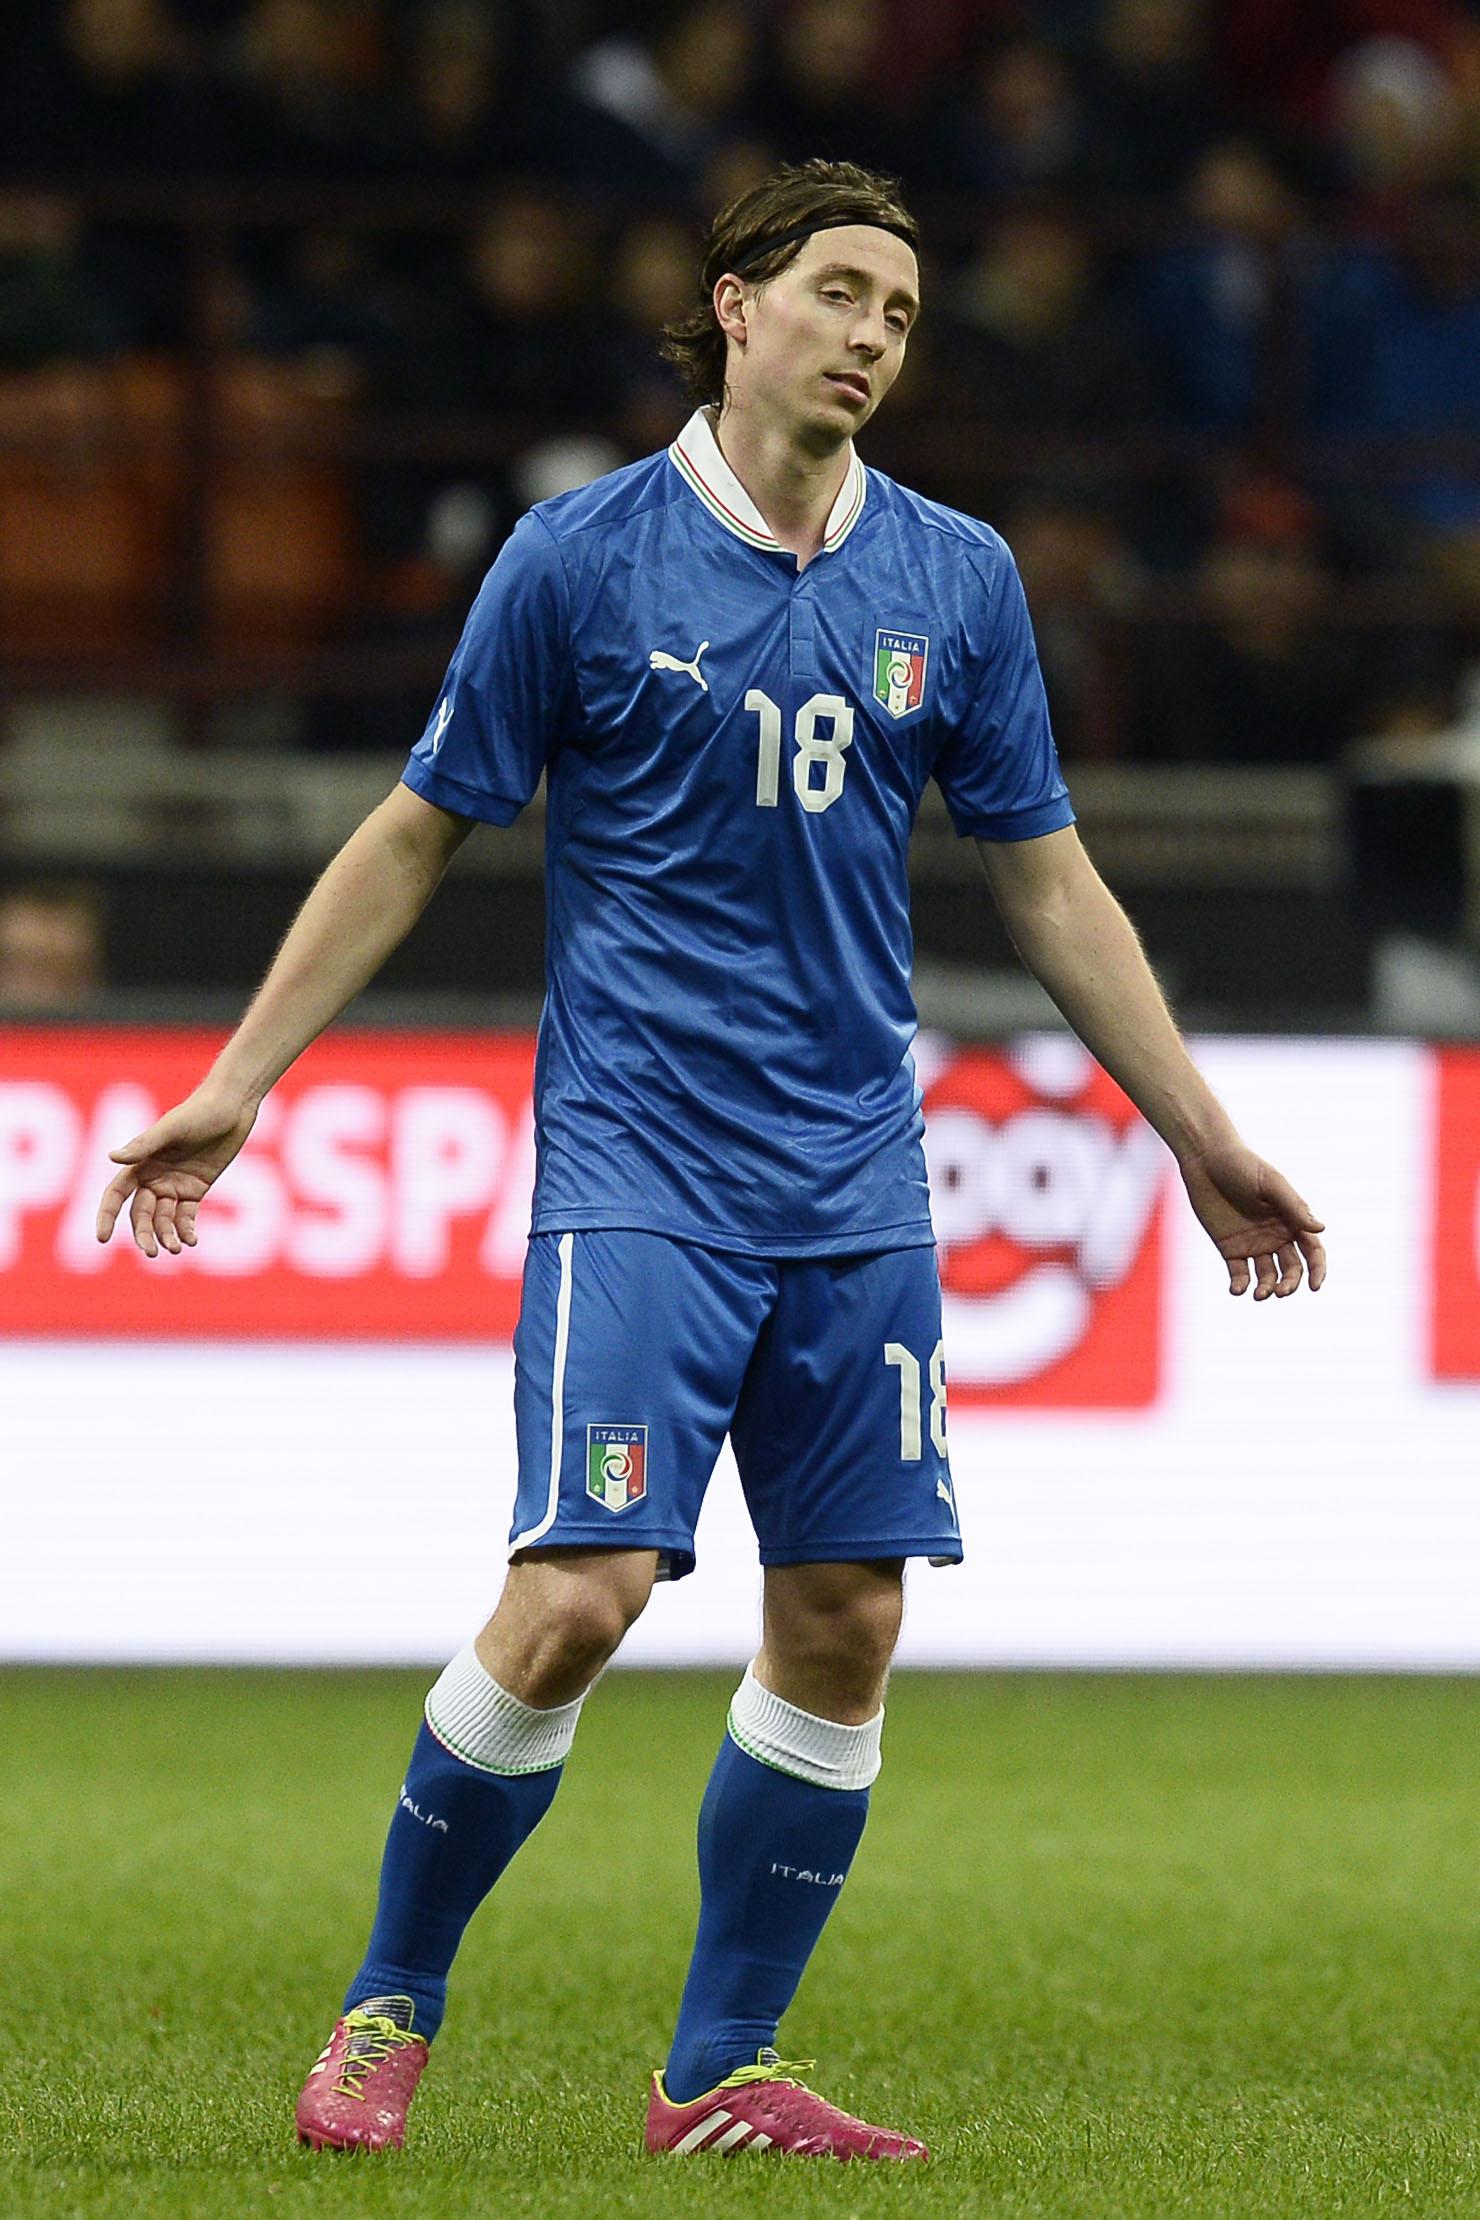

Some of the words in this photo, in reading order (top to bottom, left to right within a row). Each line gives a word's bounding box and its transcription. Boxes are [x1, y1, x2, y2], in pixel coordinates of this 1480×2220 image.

[882, 637, 920, 651] ITALIA
[744, 689, 855, 813] 18
[596, 1431, 639, 1442] ITALIA
[770, 1863, 844, 1886] ITALIA
